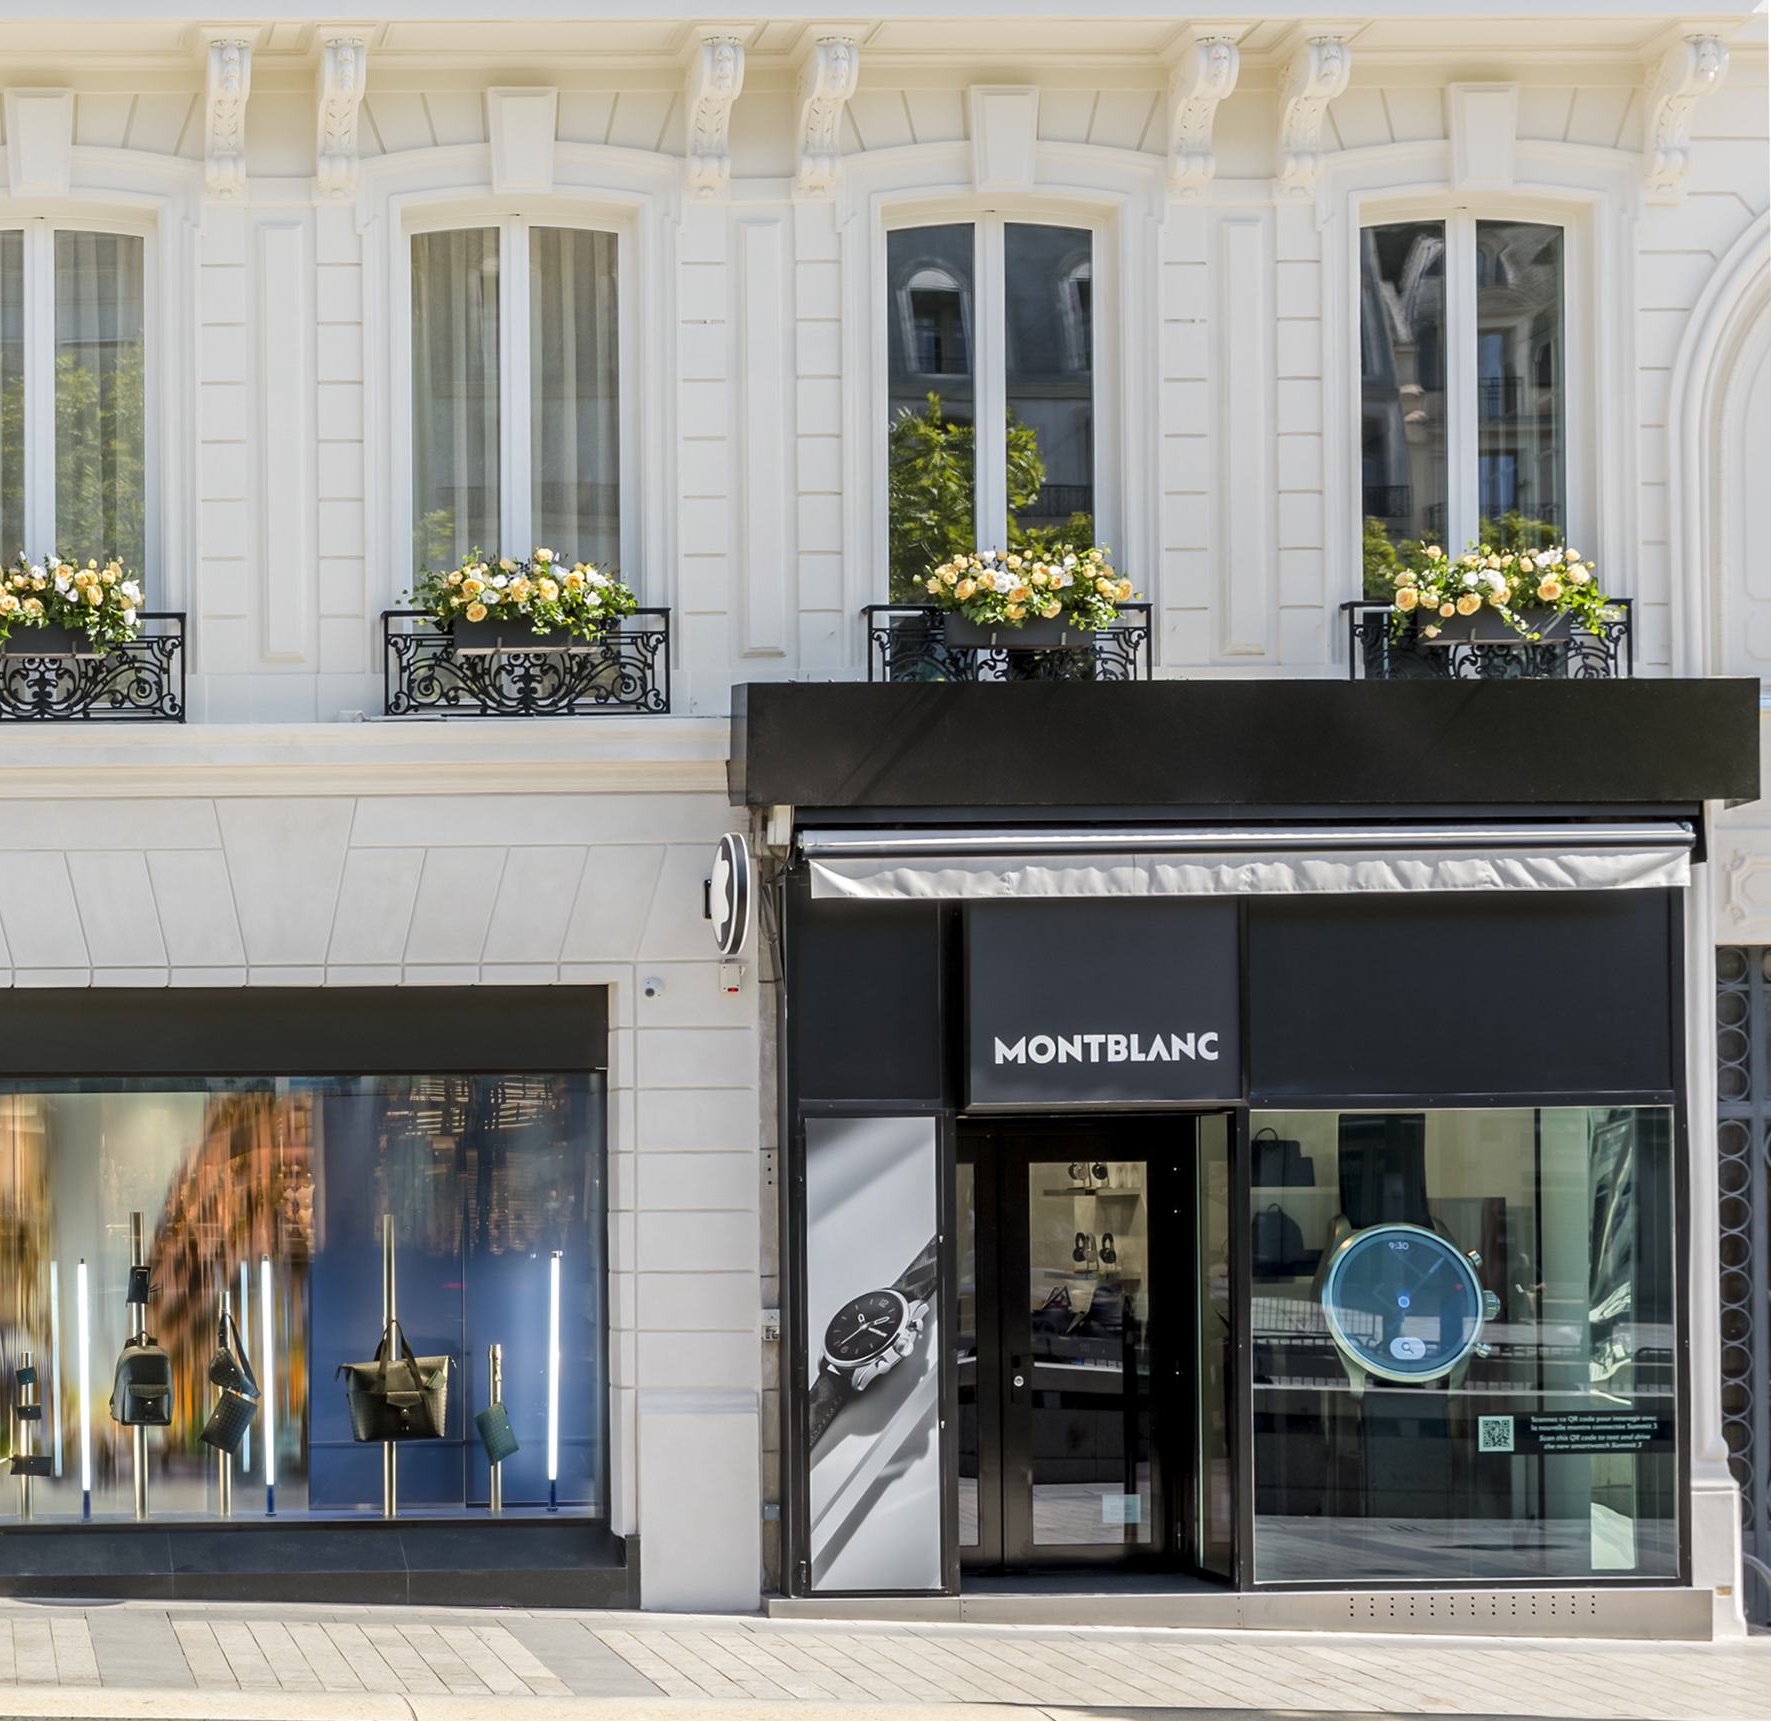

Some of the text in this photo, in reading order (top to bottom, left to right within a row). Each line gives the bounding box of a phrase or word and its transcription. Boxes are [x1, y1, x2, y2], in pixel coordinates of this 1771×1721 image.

[994, 1031, 1220, 1066] MONTBLANC
[1388, 1241, 1409, 1250] 9:30
[878, 1298, 889, 1309] 12
[1567, 1415, 1579, 1423] QR
[1569, 1434, 1581, 1442] QR
